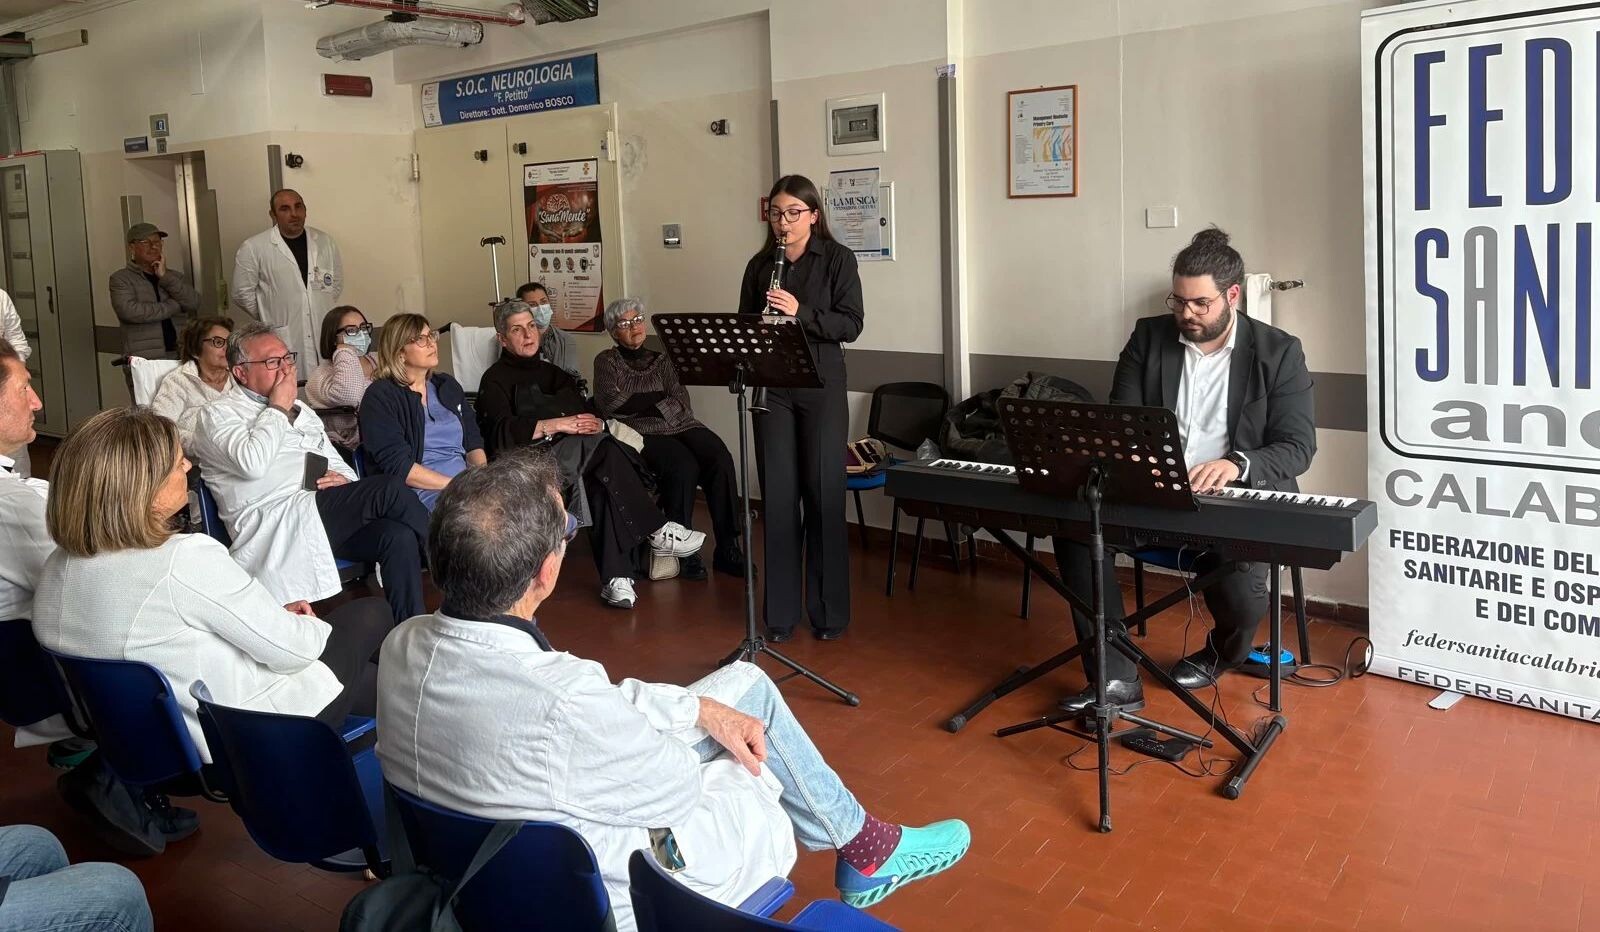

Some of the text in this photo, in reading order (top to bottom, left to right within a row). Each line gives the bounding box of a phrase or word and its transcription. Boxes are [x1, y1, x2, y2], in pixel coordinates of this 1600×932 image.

[455, 62, 574, 98] S.O.C. NEUROLOGIA
[459, 95, 574, 120] Direttore: Dott. Domenico BOSCO
[1413, 31, 1600, 212] FED
[844, 196, 876, 206] MUSICA
[1414, 222, 1592, 390] SANI
[1385, 468, 1600, 528] CALAB
[1389, 528, 1600, 576] FEDERAZIONE DEL
[1403, 558, 1600, 606] SANITARIE E OSP
[1475, 597, 1600, 638] E DEI COM
